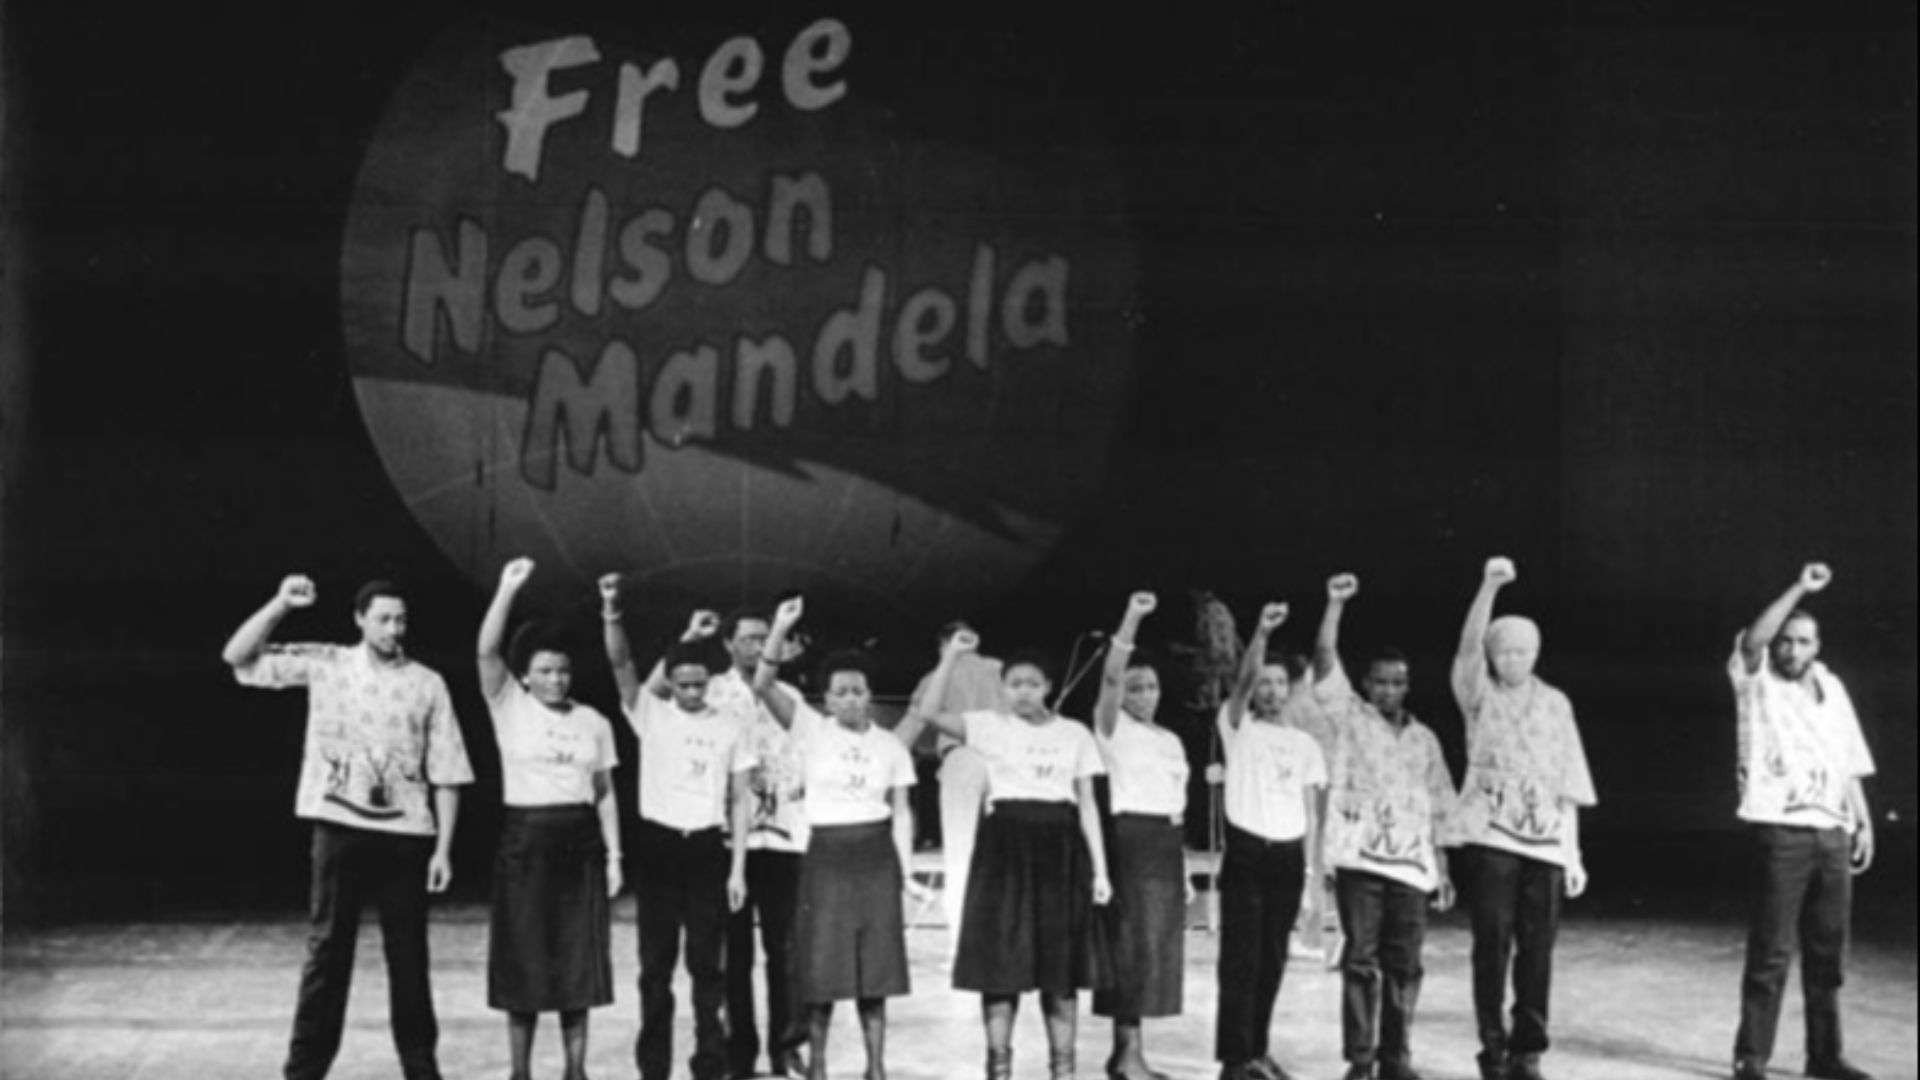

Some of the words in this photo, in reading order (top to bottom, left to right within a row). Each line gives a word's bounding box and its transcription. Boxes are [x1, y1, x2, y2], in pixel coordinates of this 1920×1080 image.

[496, 17, 852, 181] Free
[404, 171, 833, 363] Nelson
[519, 241, 1070, 492] Mandela
